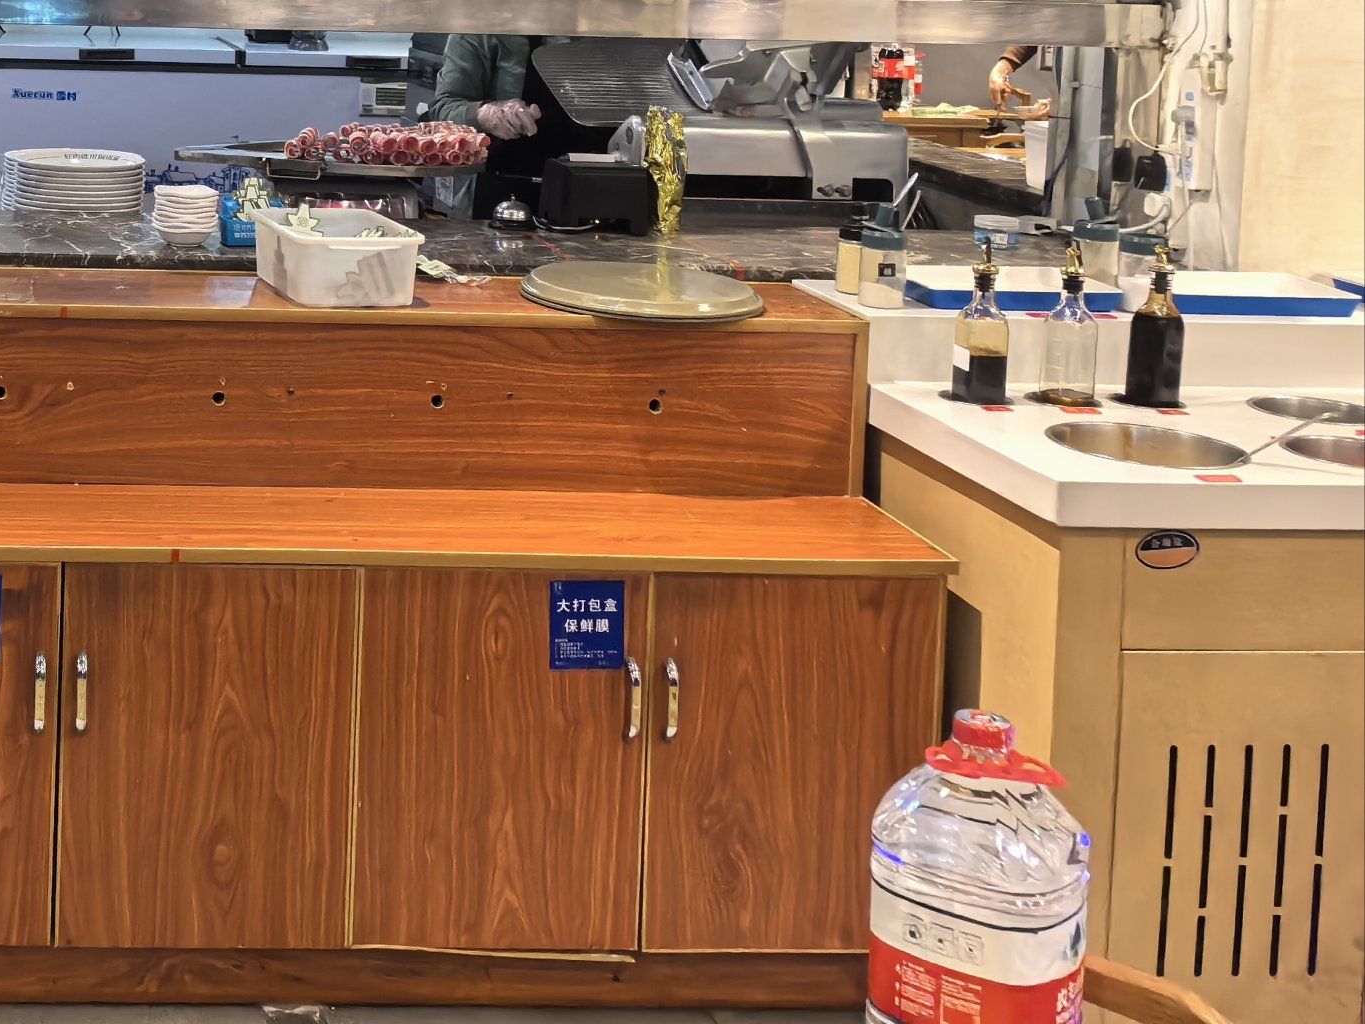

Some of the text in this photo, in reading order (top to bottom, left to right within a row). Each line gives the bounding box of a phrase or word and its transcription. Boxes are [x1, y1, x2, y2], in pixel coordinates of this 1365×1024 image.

[556, 598, 618, 613] 大打包盒
[564, 618, 610, 634] 保鲜膜
